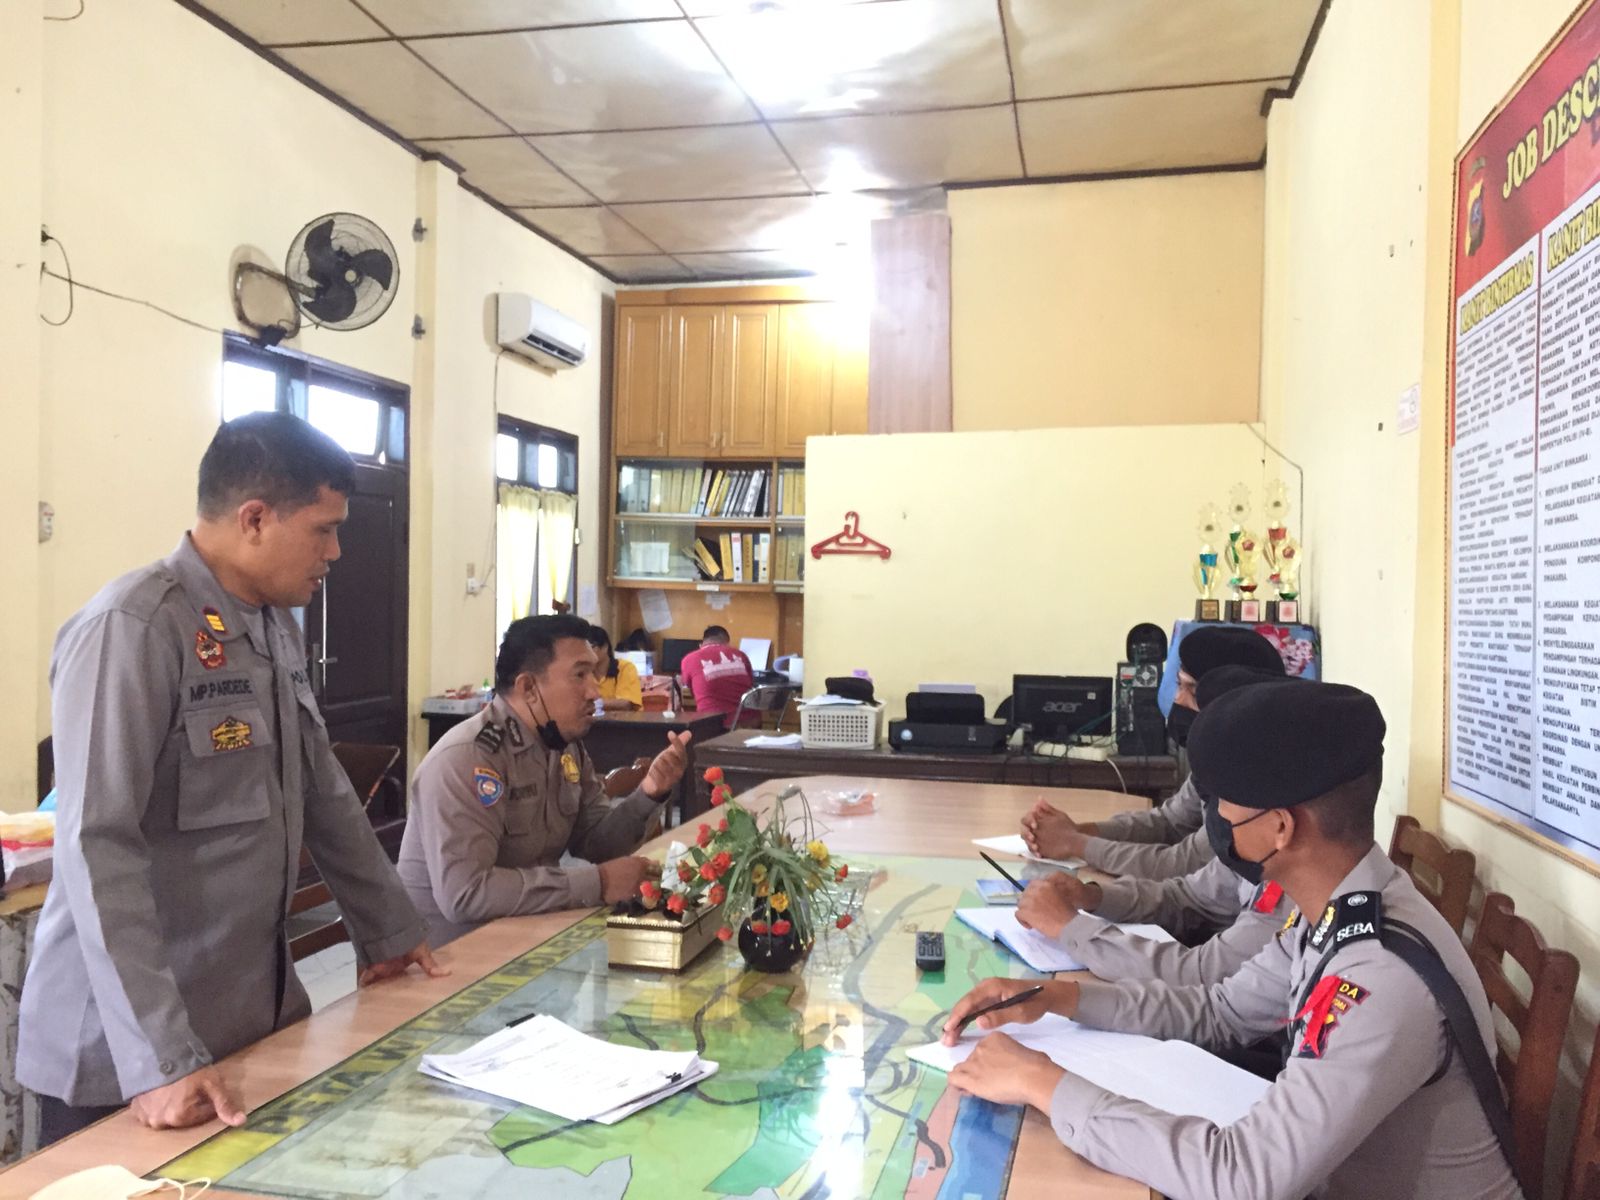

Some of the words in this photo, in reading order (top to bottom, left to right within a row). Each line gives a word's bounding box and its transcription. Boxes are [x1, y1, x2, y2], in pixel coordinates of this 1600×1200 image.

[1503, 126, 1539, 201] JOB
[1540, 56, 1600, 168] DESC
[1547, 210, 1585, 274] KANIT
[1042, 700, 1084, 713] acer
[1336, 922, 1376, 942] SEBA
